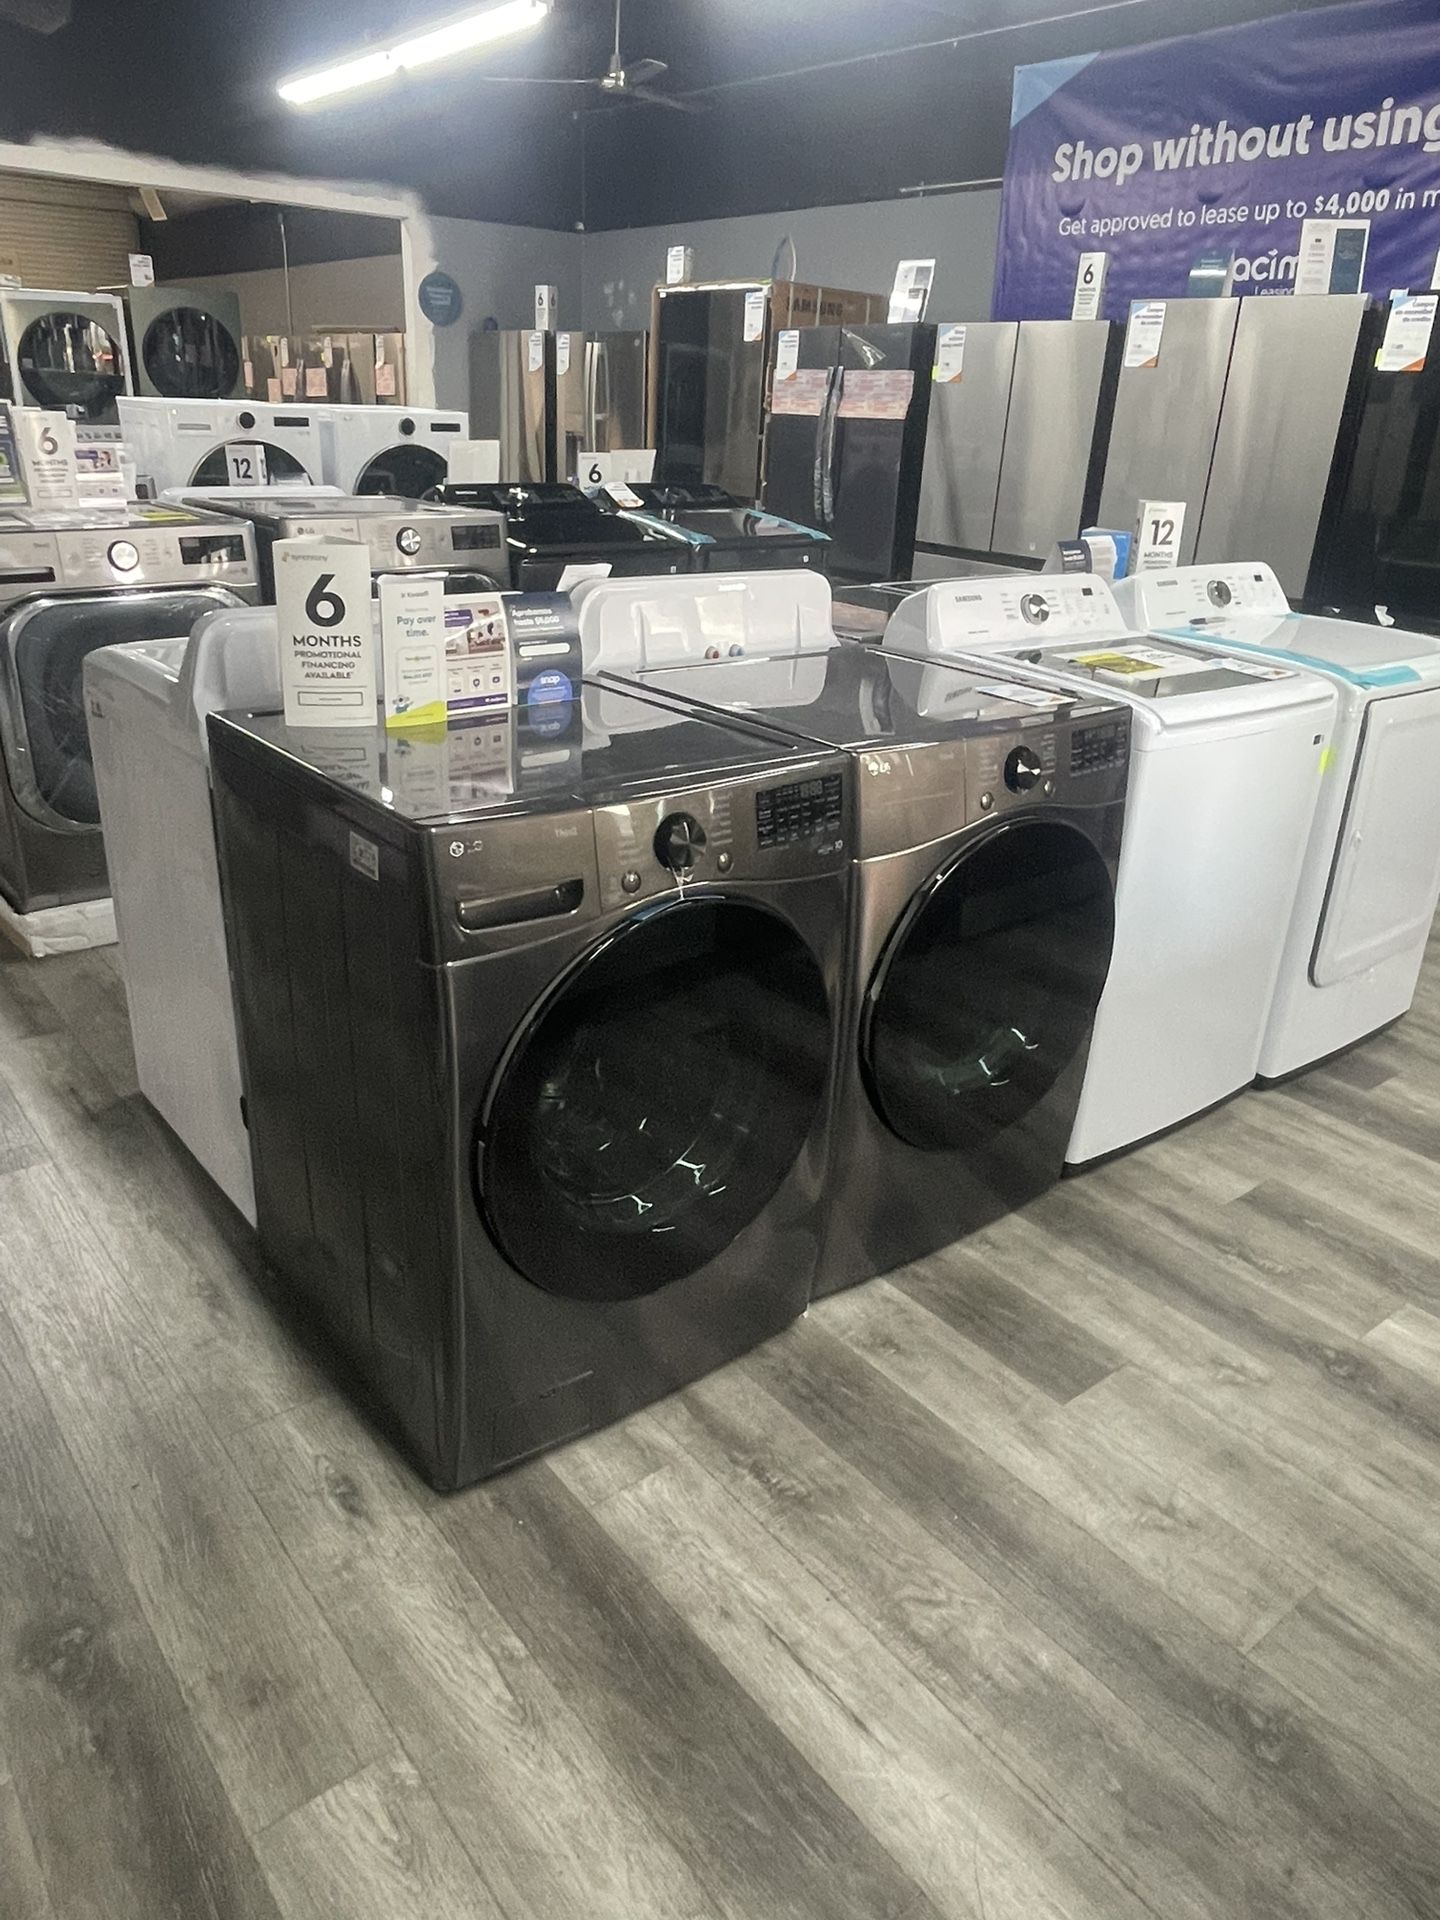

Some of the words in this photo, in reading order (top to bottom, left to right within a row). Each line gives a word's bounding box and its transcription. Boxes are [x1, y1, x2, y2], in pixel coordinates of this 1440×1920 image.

[1051, 141, 1143, 186] Shop
[1152, 113, 1315, 171] without
[1322, 97, 1440, 153] using
[1058, 217, 1087, 237] Get
[1090, 206, 1174, 238] approved
[1177, 209, 1196, 229] to
[1200, 203, 1249, 226] lease
[1254, 203, 1281, 225] up
[1286, 198, 1308, 220] to
[1314, 188, 1390, 219] $4,000
[1394, 187, 1416, 210] in
[1083, 263, 1094, 285] 6
[1254, 285, 1295, 295] Leasin
[40, 426, 58, 455] 6
[232, 457, 253, 479] 12
[589, 463, 602, 484] 6
[1151, 519, 1175, 546] 12
[305, 573, 346, 628] 6
[396, 615, 415, 627] Pay
[293, 635, 362, 647] MONTHS
[294, 650, 362, 659] PROMOTIONAL
[301, 660, 355, 670] FINANCING
